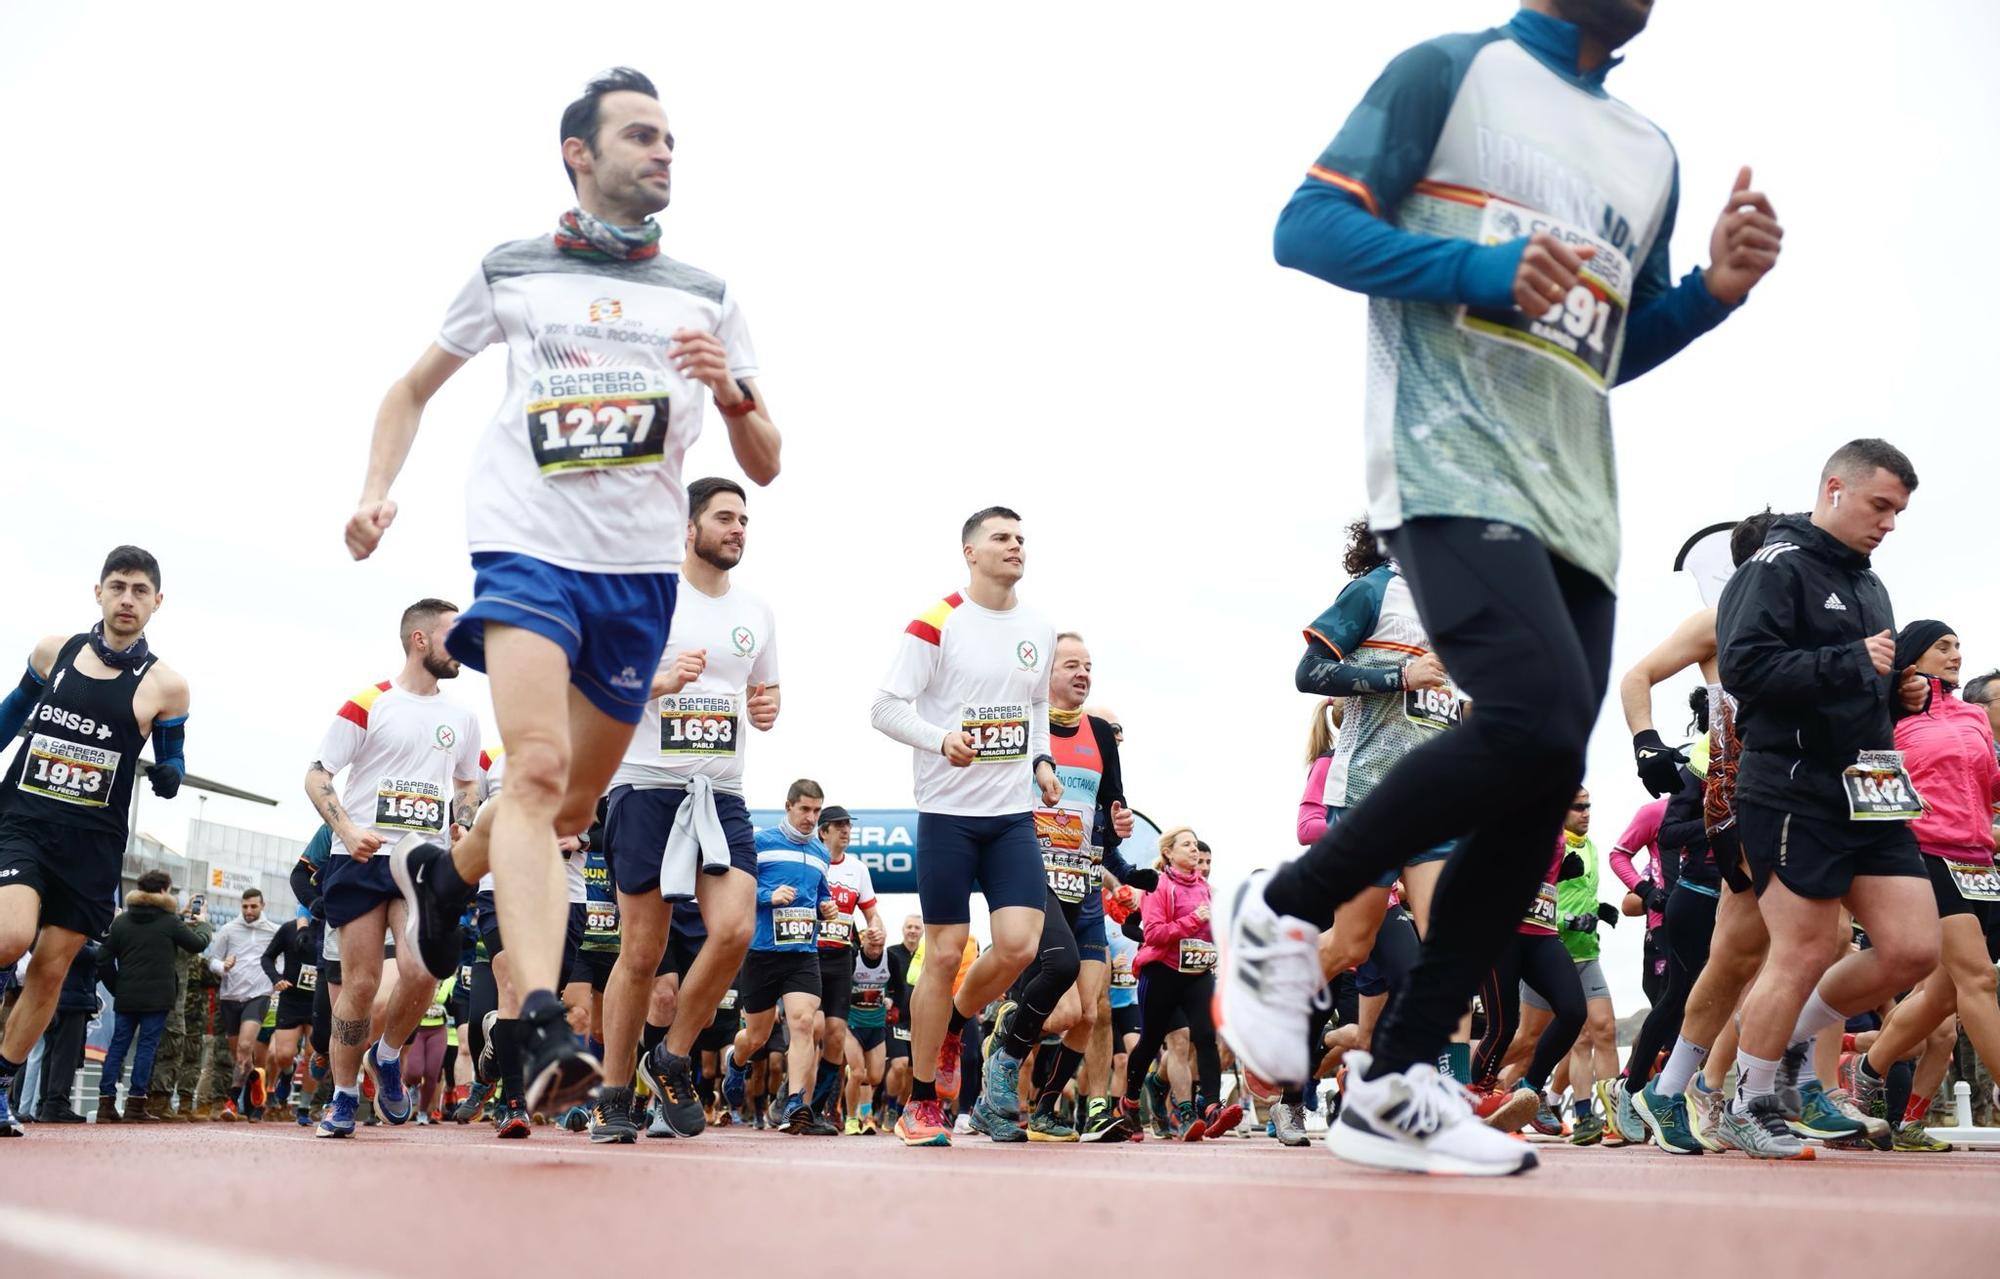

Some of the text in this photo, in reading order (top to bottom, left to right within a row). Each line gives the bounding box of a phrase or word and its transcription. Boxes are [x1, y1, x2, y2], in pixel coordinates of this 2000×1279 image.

[550, 372, 645, 386] CARRERA
[551, 382, 647, 396] DEL EBRO
[540, 405, 656, 450] 1227
[679, 697, 730, 706] CARRERA
[670, 719, 732, 742] 1633
[971, 726, 1025, 749] 1250
[49, 747, 104, 764] DEL EBRO
[51, 741, 105, 757] CARRERA
[34, 760, 102, 792] 1913
[47, 785, 80, 796] ALFREDO
[396, 780, 438, 790] CARRERA
[417, 788, 438, 796] EBRO
[385, 798, 438, 822] 1593
[1047, 872, 1086, 893] 1524
[838, 892, 848, 903] 45
[586, 914, 615, 927] 616
[781, 921, 813, 936] 1604
